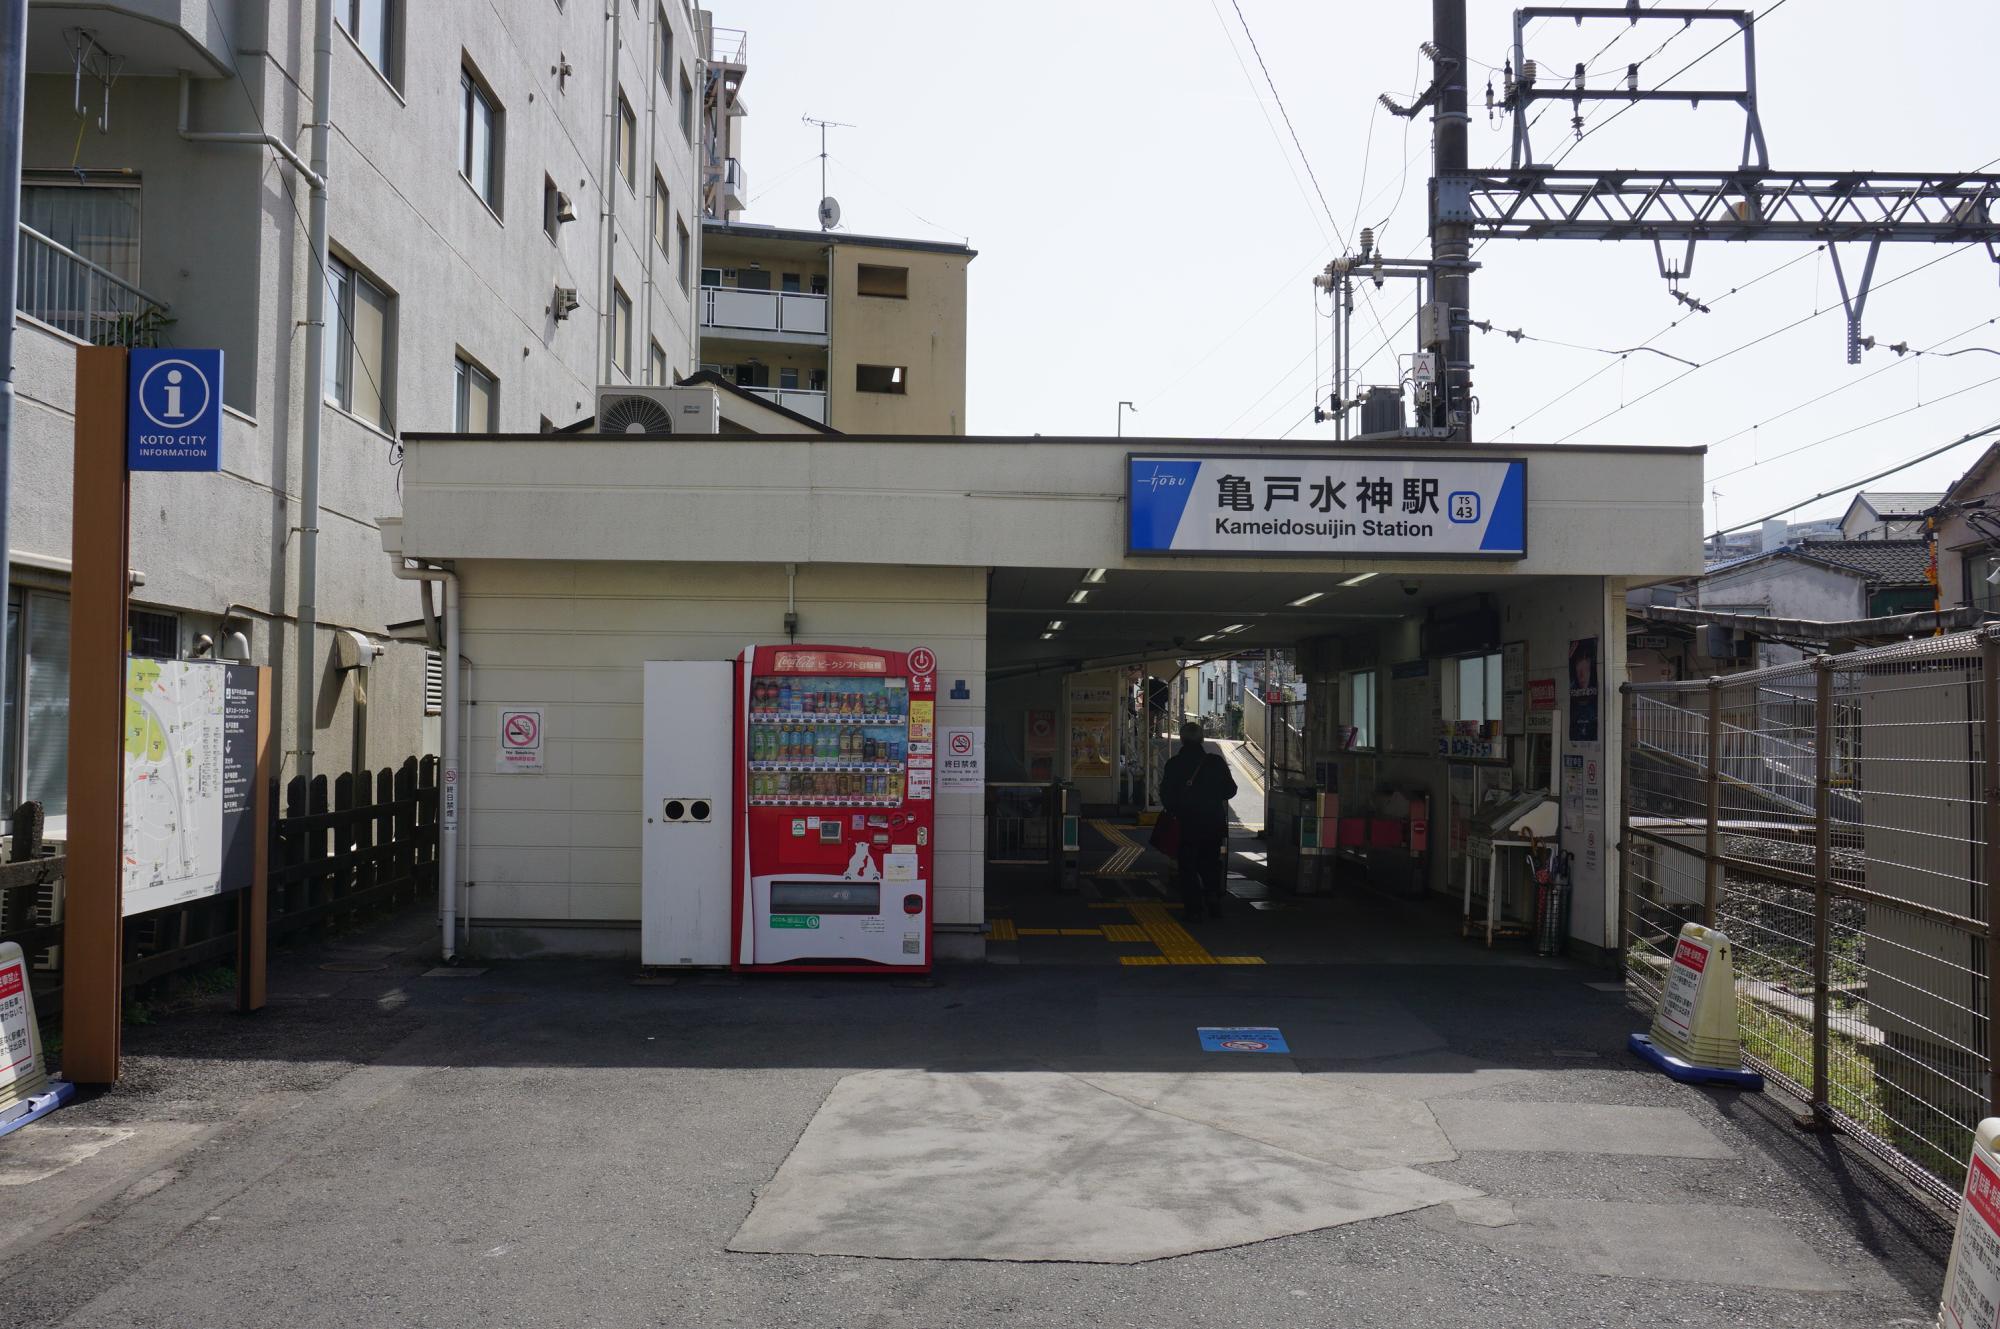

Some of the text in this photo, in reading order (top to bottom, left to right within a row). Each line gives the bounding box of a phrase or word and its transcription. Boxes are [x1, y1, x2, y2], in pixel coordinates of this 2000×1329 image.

[1418, 360, 1430, 374] A
[140, 435, 206, 445] KOTO CITY
[1217, 475, 1440, 514] 亀戸水神駅
[1459, 497, 1471, 505] TS
[1456, 507, 1473, 519] 43
[1216, 518, 1433, 539] Kameidosuijin Station
[945, 760, 977, 768] 終日禁煙
